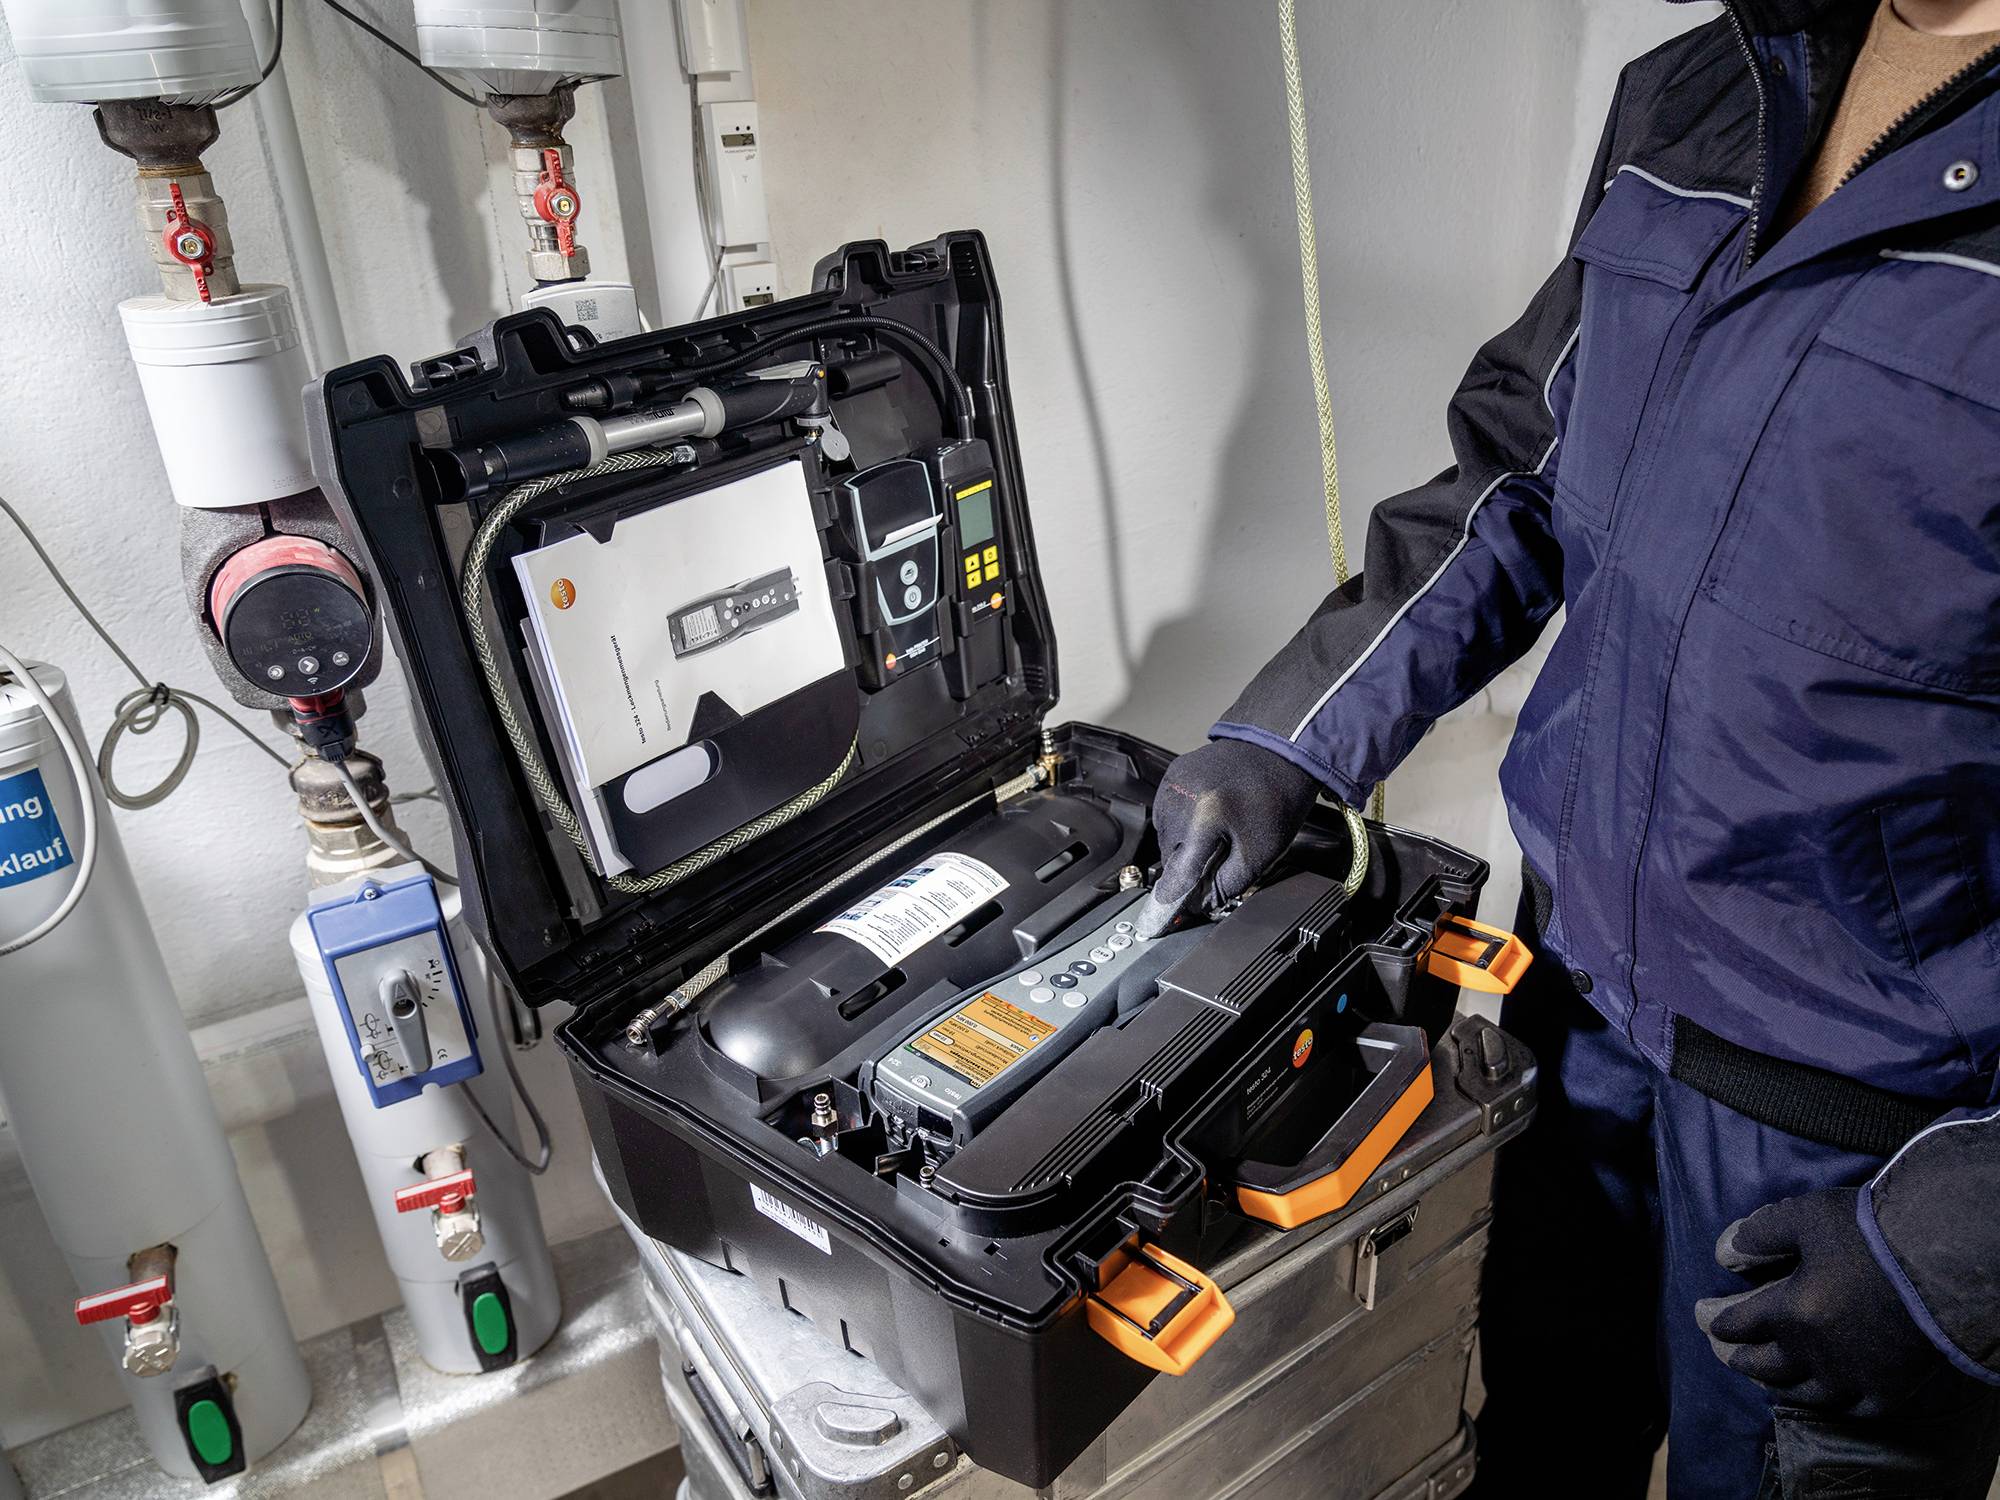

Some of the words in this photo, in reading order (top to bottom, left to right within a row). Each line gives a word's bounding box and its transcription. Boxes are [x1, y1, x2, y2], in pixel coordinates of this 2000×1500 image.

[557, 579, 570, 609] testo
[633, 714, 642, 728] 324
[638, 727, 646, 744] testo
[1293, 1037, 1313, 1060] testo
[888, 1057, 902, 1067] 324
[944, 1088, 962, 1100] testo
